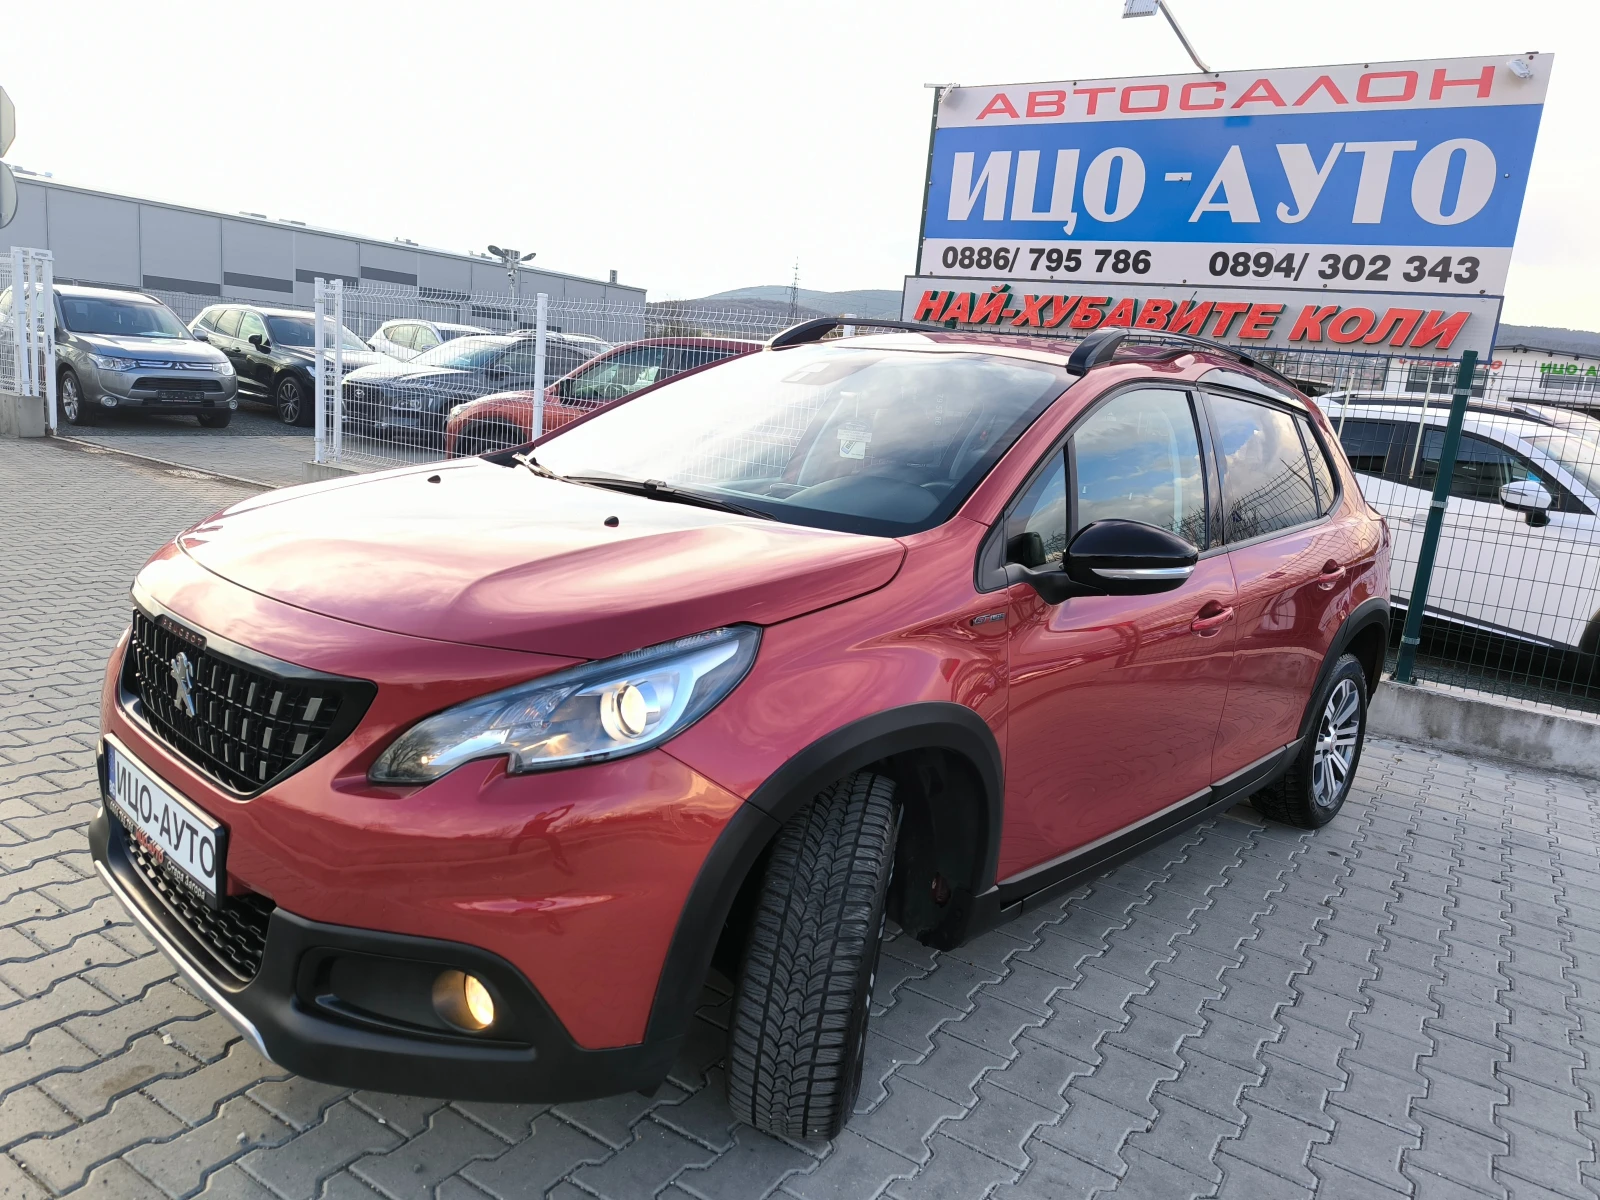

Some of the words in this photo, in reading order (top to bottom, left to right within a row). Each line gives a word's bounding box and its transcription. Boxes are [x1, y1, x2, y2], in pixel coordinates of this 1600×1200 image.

[976, 66, 1496, 120] АВТОСАЛОН
[942, 246, 1021, 273] 0886/
[1028, 247, 1082, 273] 795
[1094, 248, 1152, 275] 786
[1208, 251, 1310, 282] 0894/
[1317, 253, 1392, 282] 302
[1402, 255, 1480, 285] 343
[913, 284, 1284, 339] НАЙ-ХУБАВИТЕ
[1287, 304, 1472, 350] КОЛИ
[116, 760, 216, 879] ИЦО-АУТО
